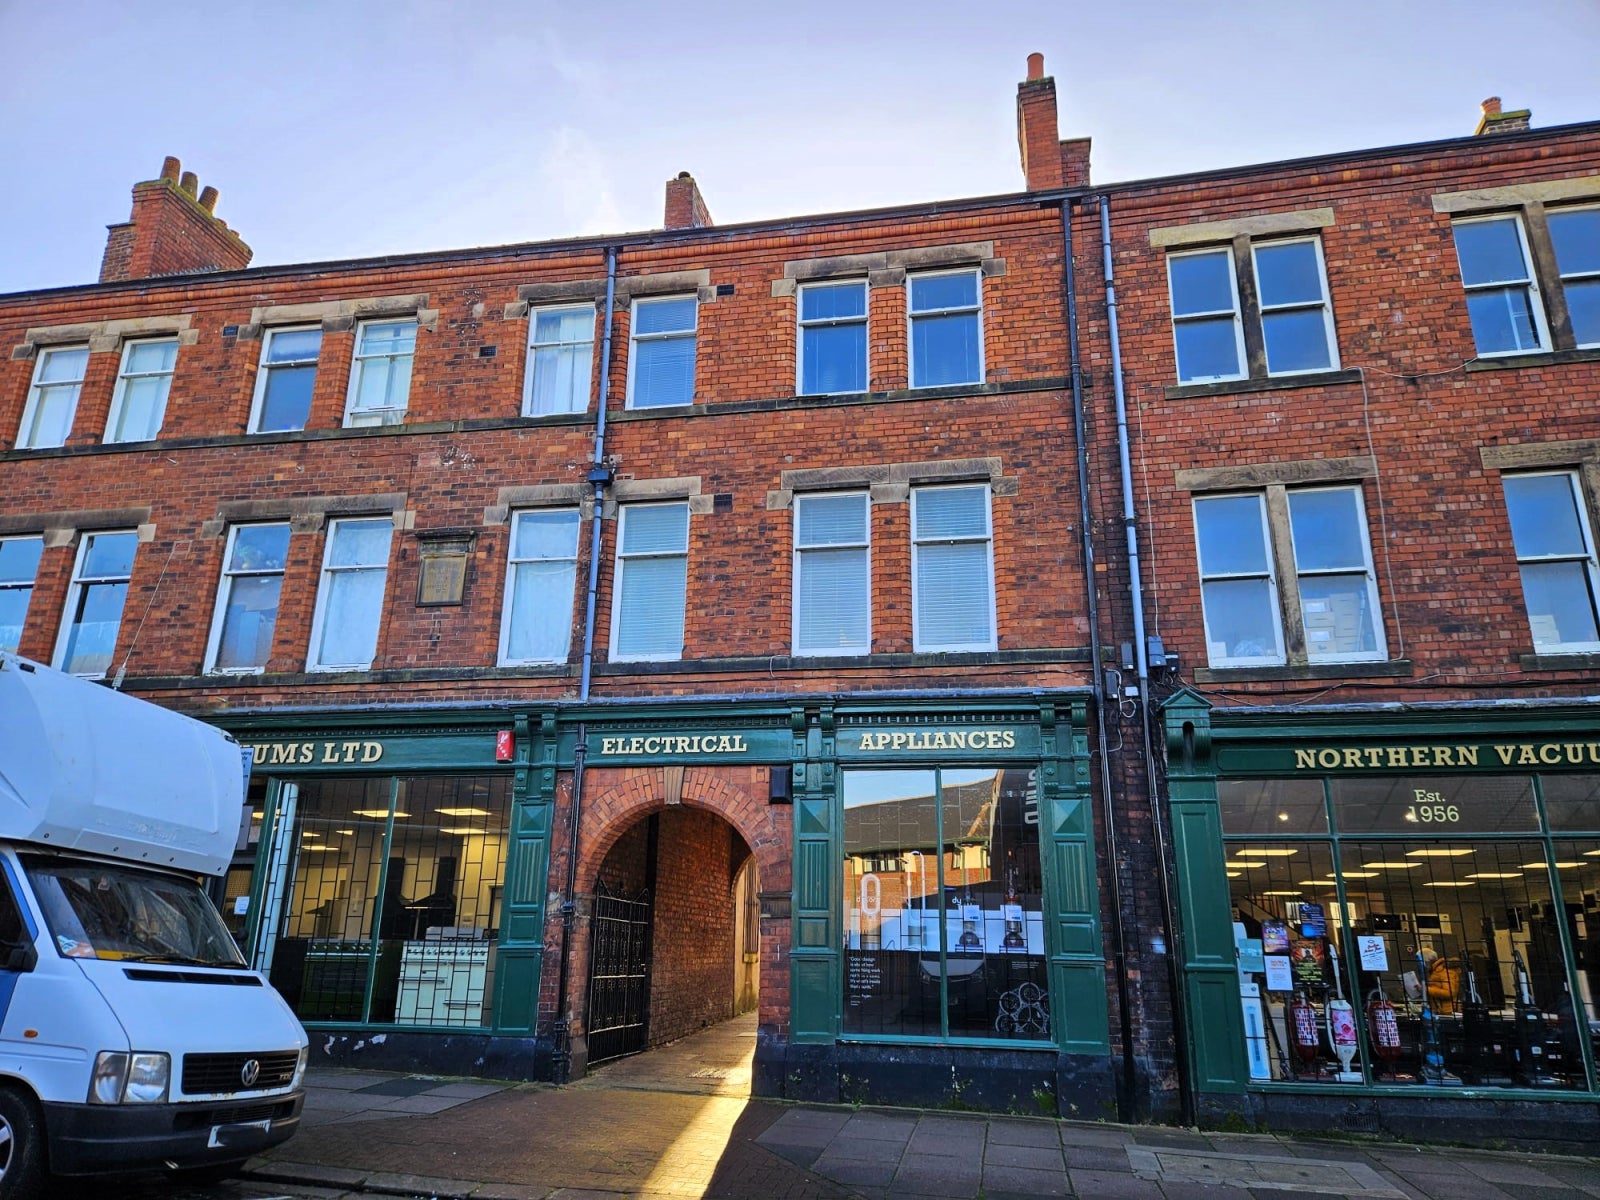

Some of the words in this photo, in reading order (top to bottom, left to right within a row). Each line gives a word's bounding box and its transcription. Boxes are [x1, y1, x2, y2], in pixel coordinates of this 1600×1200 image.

[601, 735, 748, 755] ELECTRICAL
[858, 730, 1016, 750] APPLIANCES
[240, 742, 315, 764] UMS
[322, 741, 384, 763] LTD
[1294, 745, 1480, 769] NORTHERN
[1413, 788, 1447, 803] Est.
[1407, 805, 1460, 823] 1956
